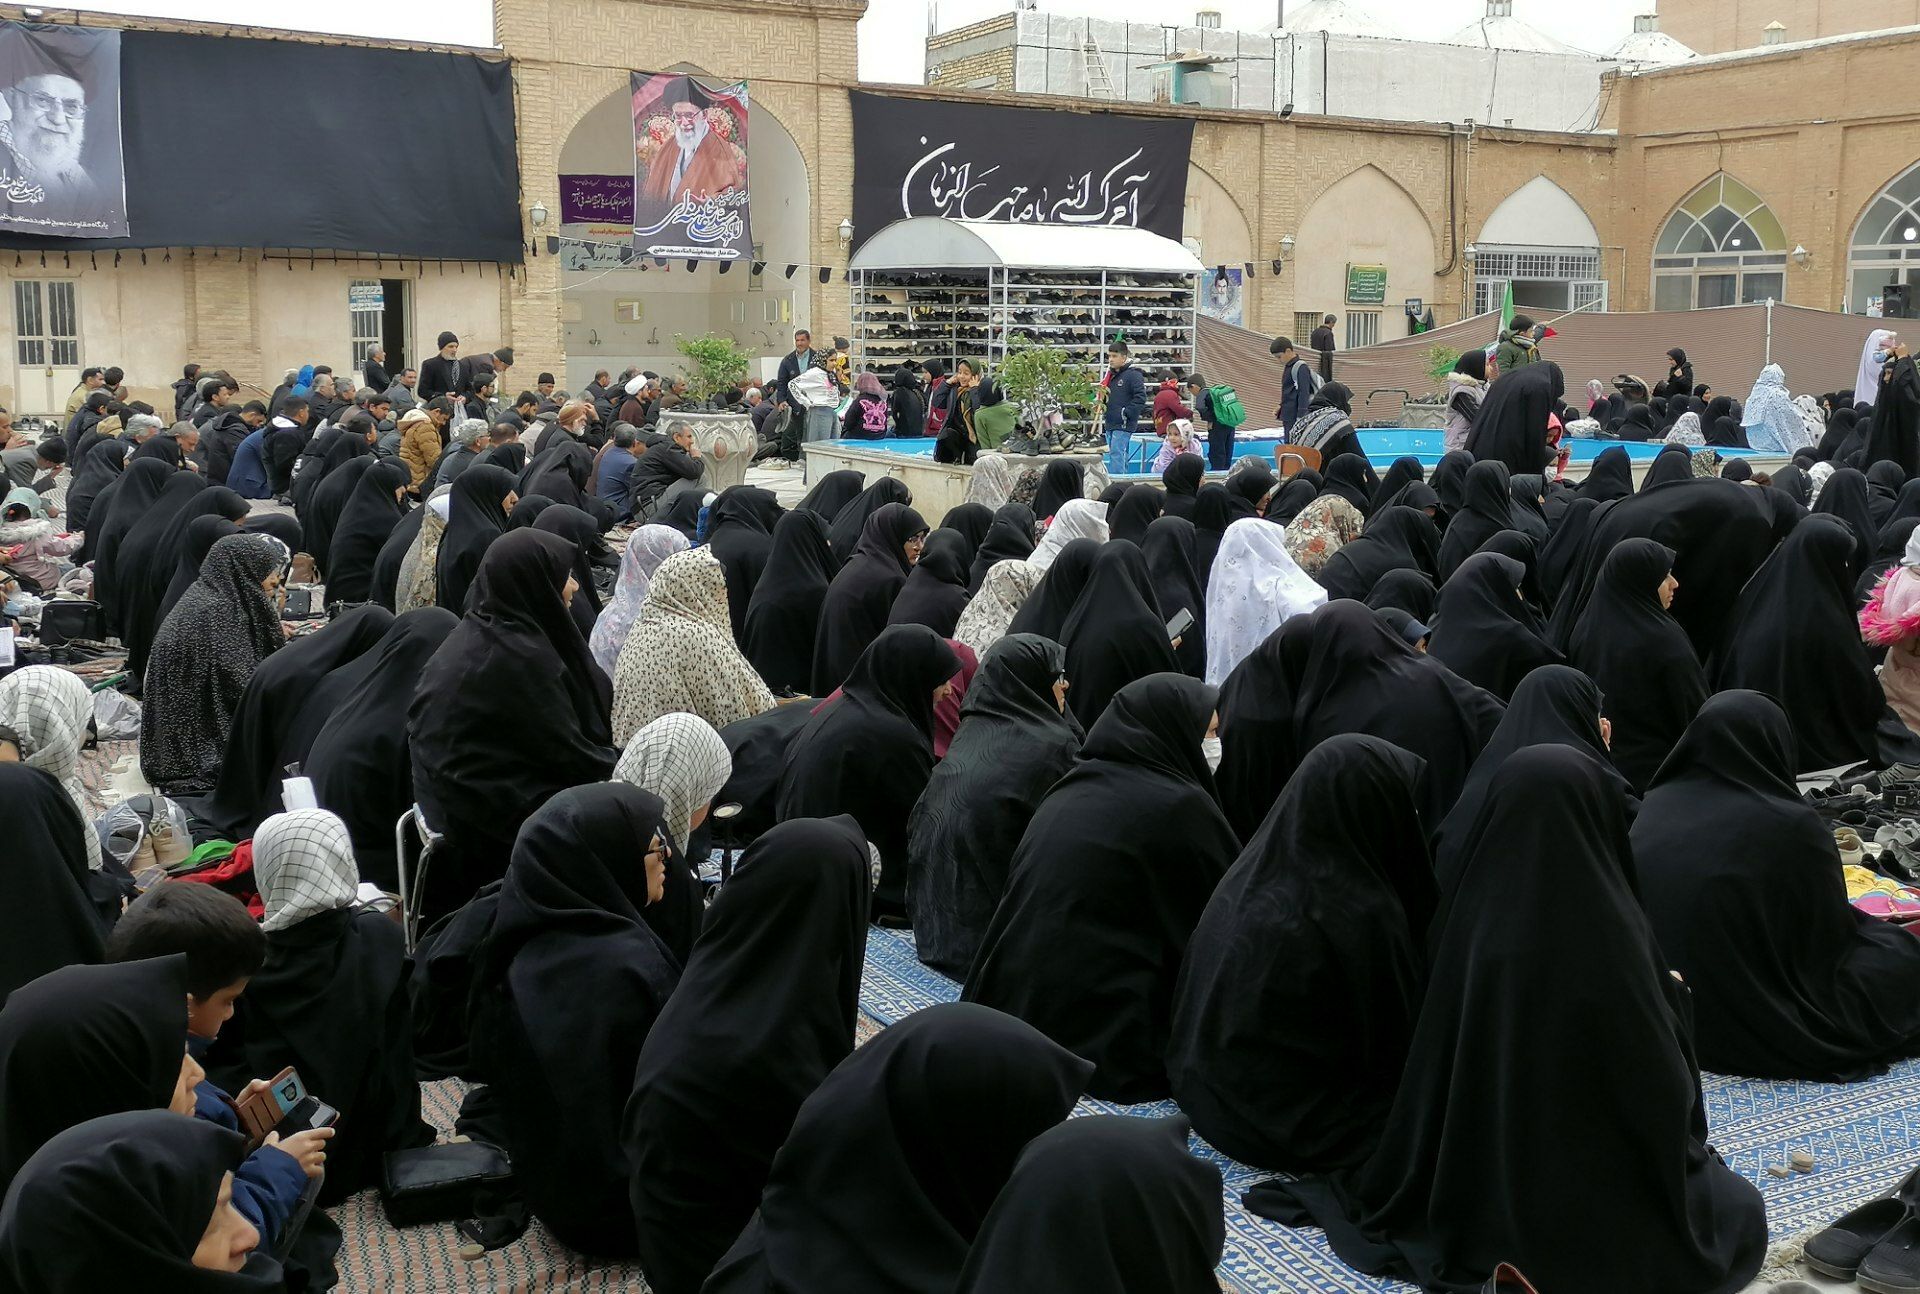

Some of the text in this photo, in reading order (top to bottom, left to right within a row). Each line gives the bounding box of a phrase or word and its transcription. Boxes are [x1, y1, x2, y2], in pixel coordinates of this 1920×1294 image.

[902, 135, 972, 219] الزمان
[1050, 170, 1093, 221] الله
[51, 219, 69, 228] بسیج
[70, 220, 92, 230] مقاومت
